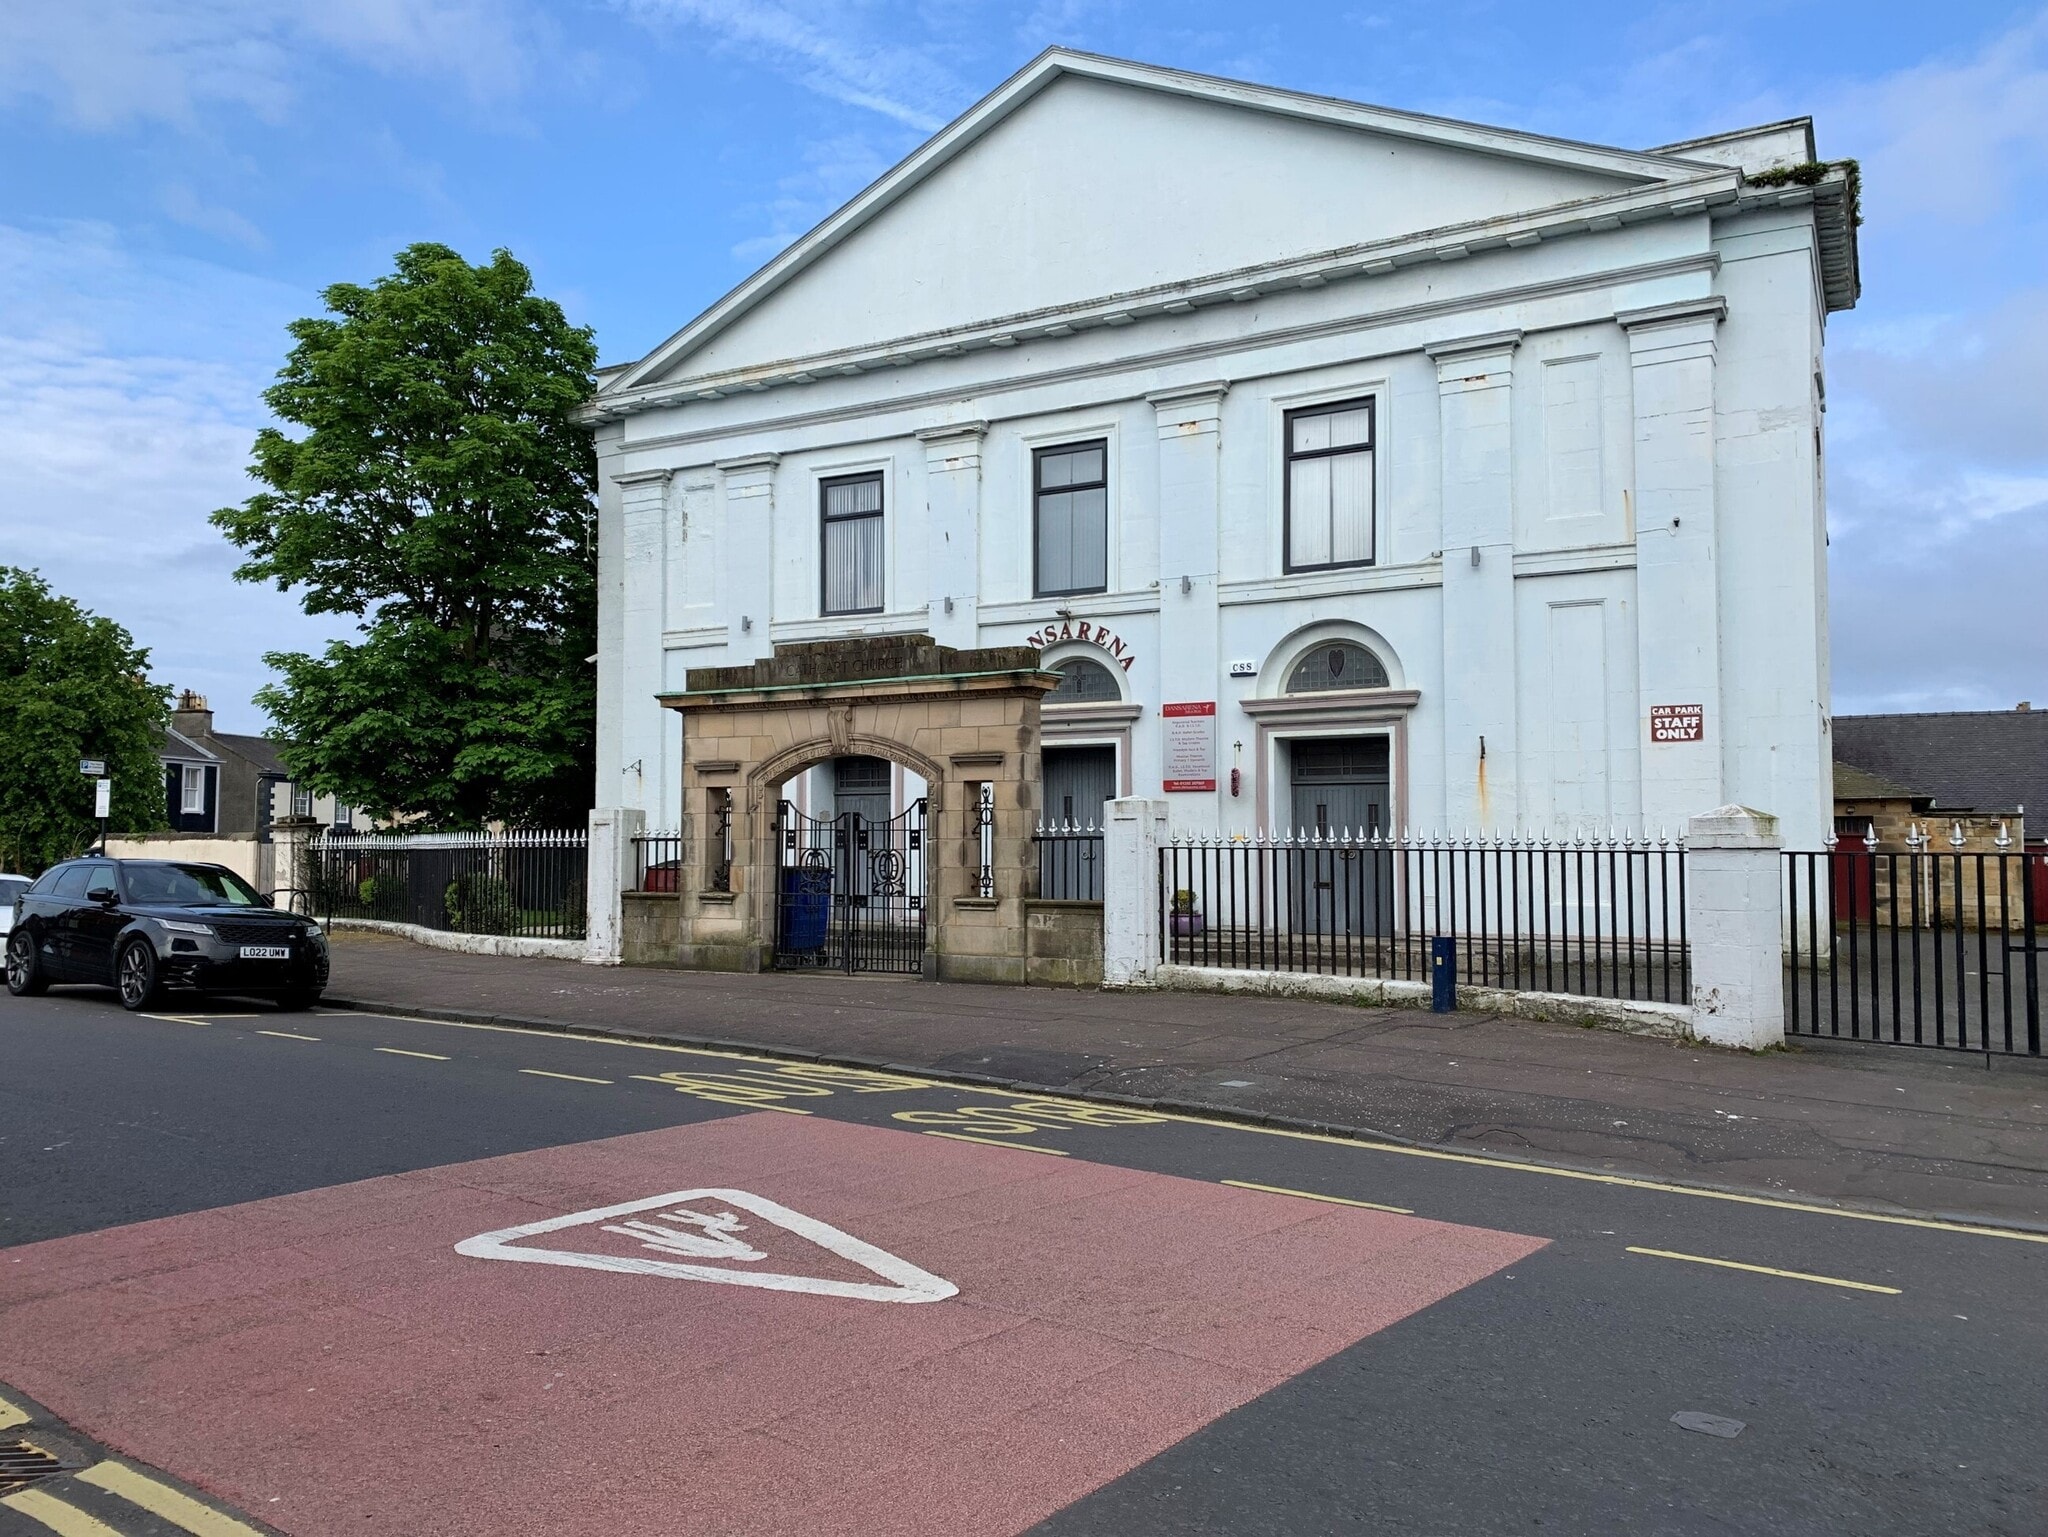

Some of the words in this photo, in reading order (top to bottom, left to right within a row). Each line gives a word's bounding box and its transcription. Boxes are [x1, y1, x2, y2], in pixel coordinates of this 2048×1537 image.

[853, 657, 903, 673] CHURCH
[1654, 717, 1700, 729] STAFF
[1656, 728, 1699, 740] ONLY
[243, 947, 267, 957] LO22
[628, 1066, 933, 1101] STOP
[891, 1103, 1167, 1134] BUS
